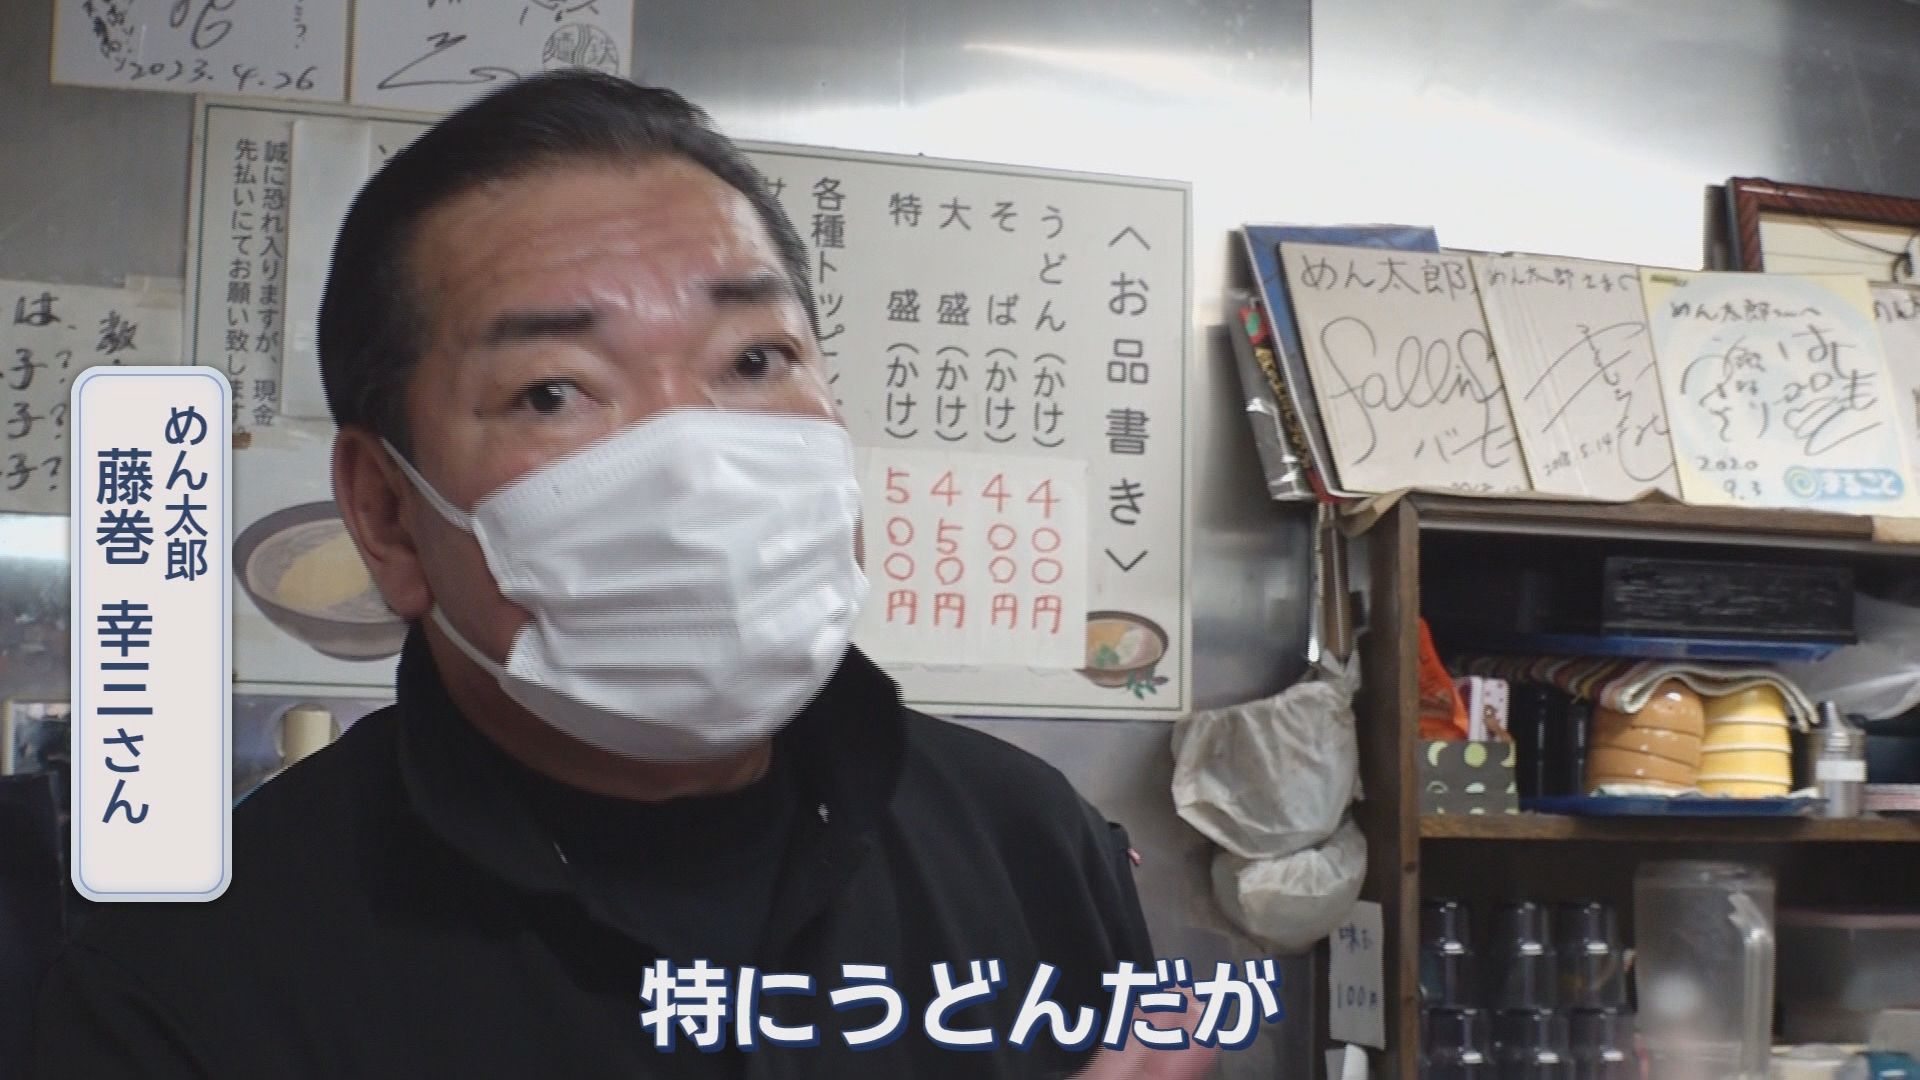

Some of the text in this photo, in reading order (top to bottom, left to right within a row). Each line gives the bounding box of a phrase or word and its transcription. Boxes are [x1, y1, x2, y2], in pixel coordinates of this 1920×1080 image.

[252, 140, 289, 428] 誠に恐れ入りますが、 現金
[884, 191, 923, 440] 特盛（かけ）
[934, 196, 972, 442] 大盛（かけ）
[983, 200, 1019, 444] そば（かけ）
[1032, 205, 1067, 449] うどん（かけ）
[1300, 255, 1468, 301] めん太郎
[884, 466, 919, 626] 500円
[930, 471, 966, 630] 450円
[981, 473, 1018, 629] 400円
[1027, 479, 1063, 634] 400円
